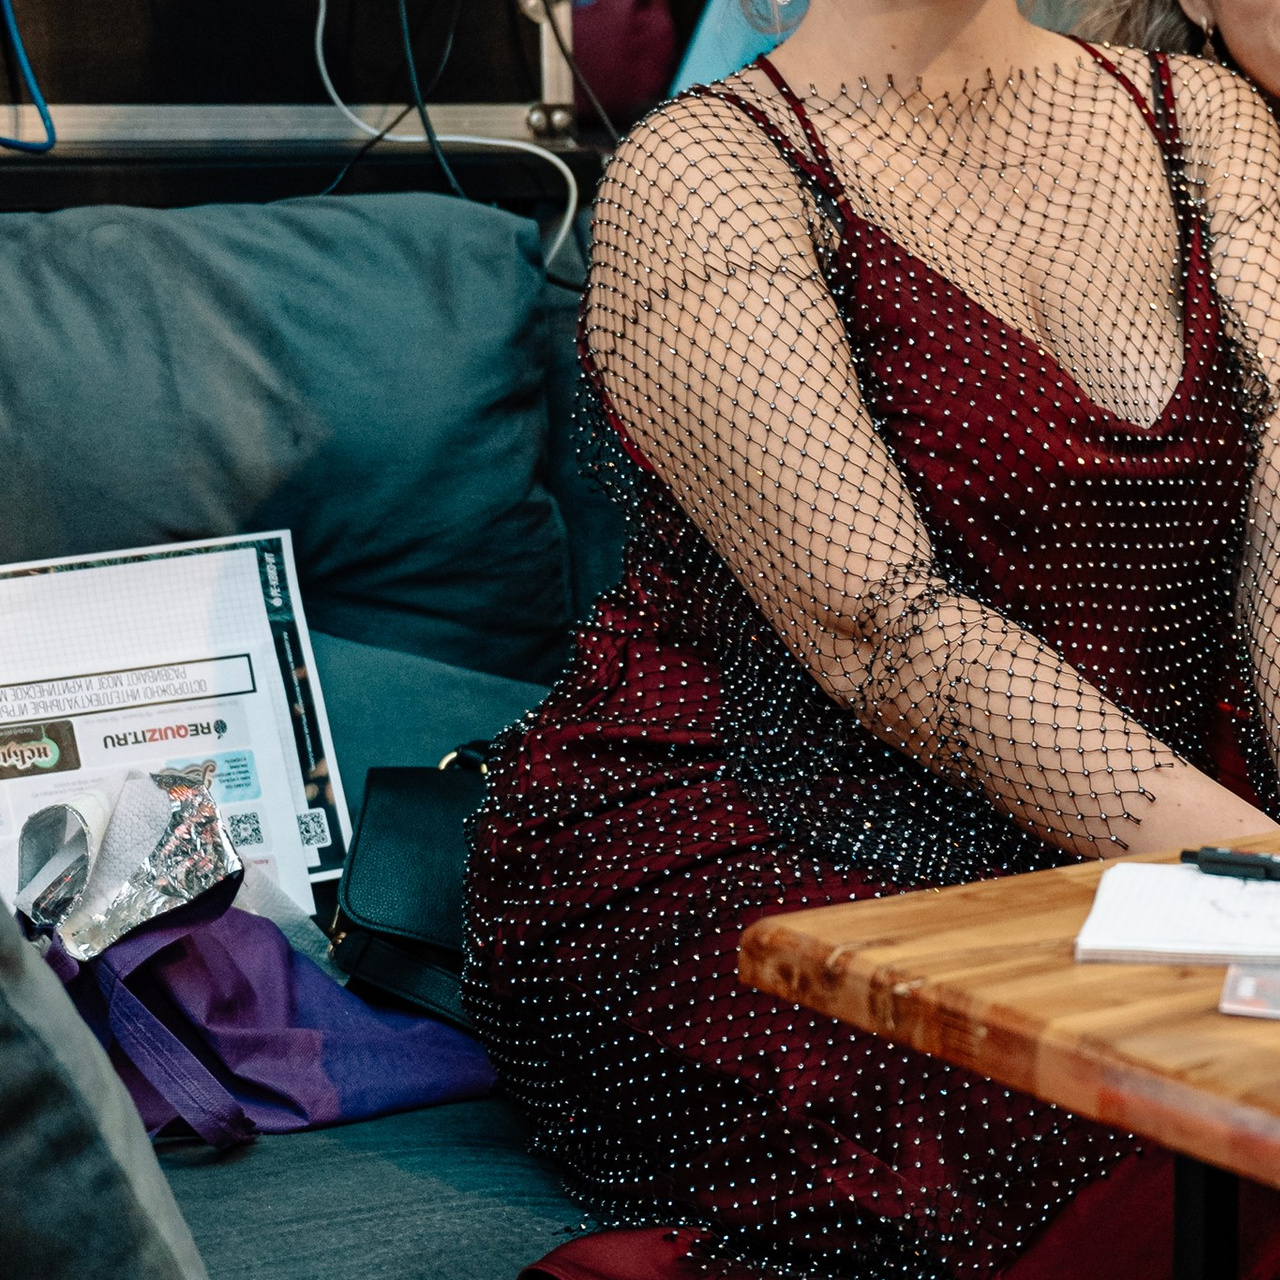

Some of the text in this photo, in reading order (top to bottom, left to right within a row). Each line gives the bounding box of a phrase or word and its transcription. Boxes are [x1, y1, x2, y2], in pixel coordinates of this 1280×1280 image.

[84, 679, 93, 693] И
[97, 674, 122, 690] МОЗГ
[123, 666, 187, 687] РАЗВИВАЮТ
[10, 681, 83, 700] КРИТИЧЕСКОЕ
[143, 678, 208, 697] ОСТОРОЖНО!
[30, 686, 141, 715] ИНТЕЛЛЕКТУАЛЬНЫЕ
[102, 721, 213, 749] REQUIZIT.RU
